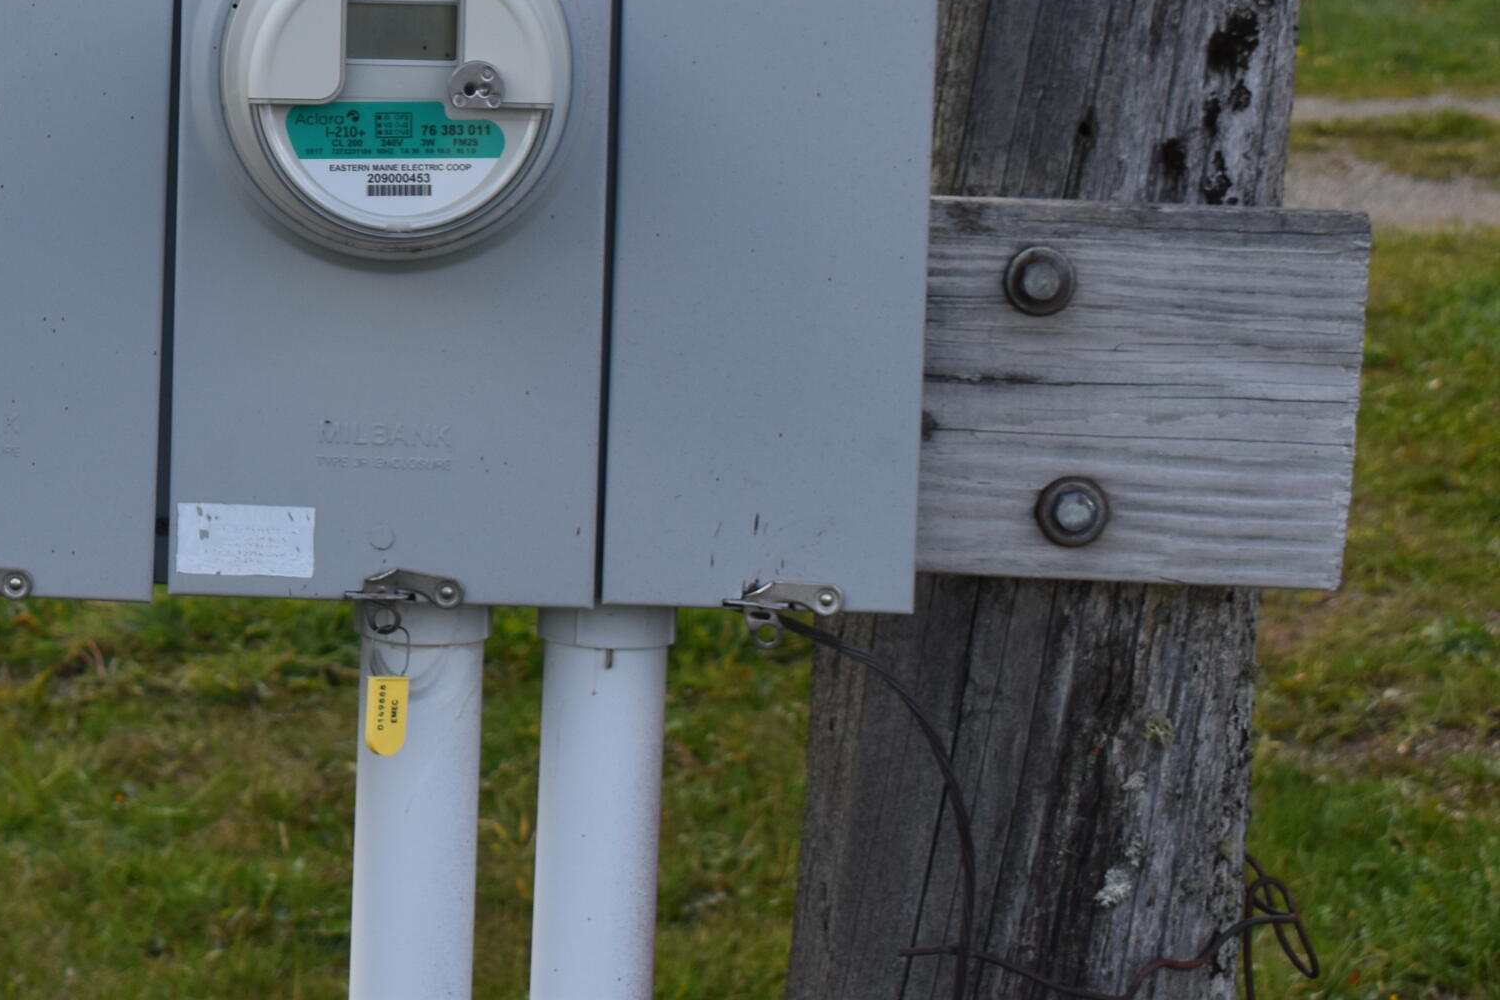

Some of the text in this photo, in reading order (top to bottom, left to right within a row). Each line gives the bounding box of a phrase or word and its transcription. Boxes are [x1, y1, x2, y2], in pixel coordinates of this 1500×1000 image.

[295, 113, 345, 125] Aclara
[325, 126, 366, 138] I-210+
[421, 125, 437, 136] 76
[441, 125, 464, 136] 383
[468, 124, 491, 136] 011
[331, 139, 364, 147] CL 200
[380, 139, 404, 148] 240V
[420, 138, 435, 147] 3W
[453, 138, 479, 147] FM2S
[329, 163, 473, 172] EASTERN MAINE ELECTRIC COOP
[367, 173, 431, 184] 209000453
[316, 419, 453, 449] MILBANK
[390, 699, 400, 724] EMEC
